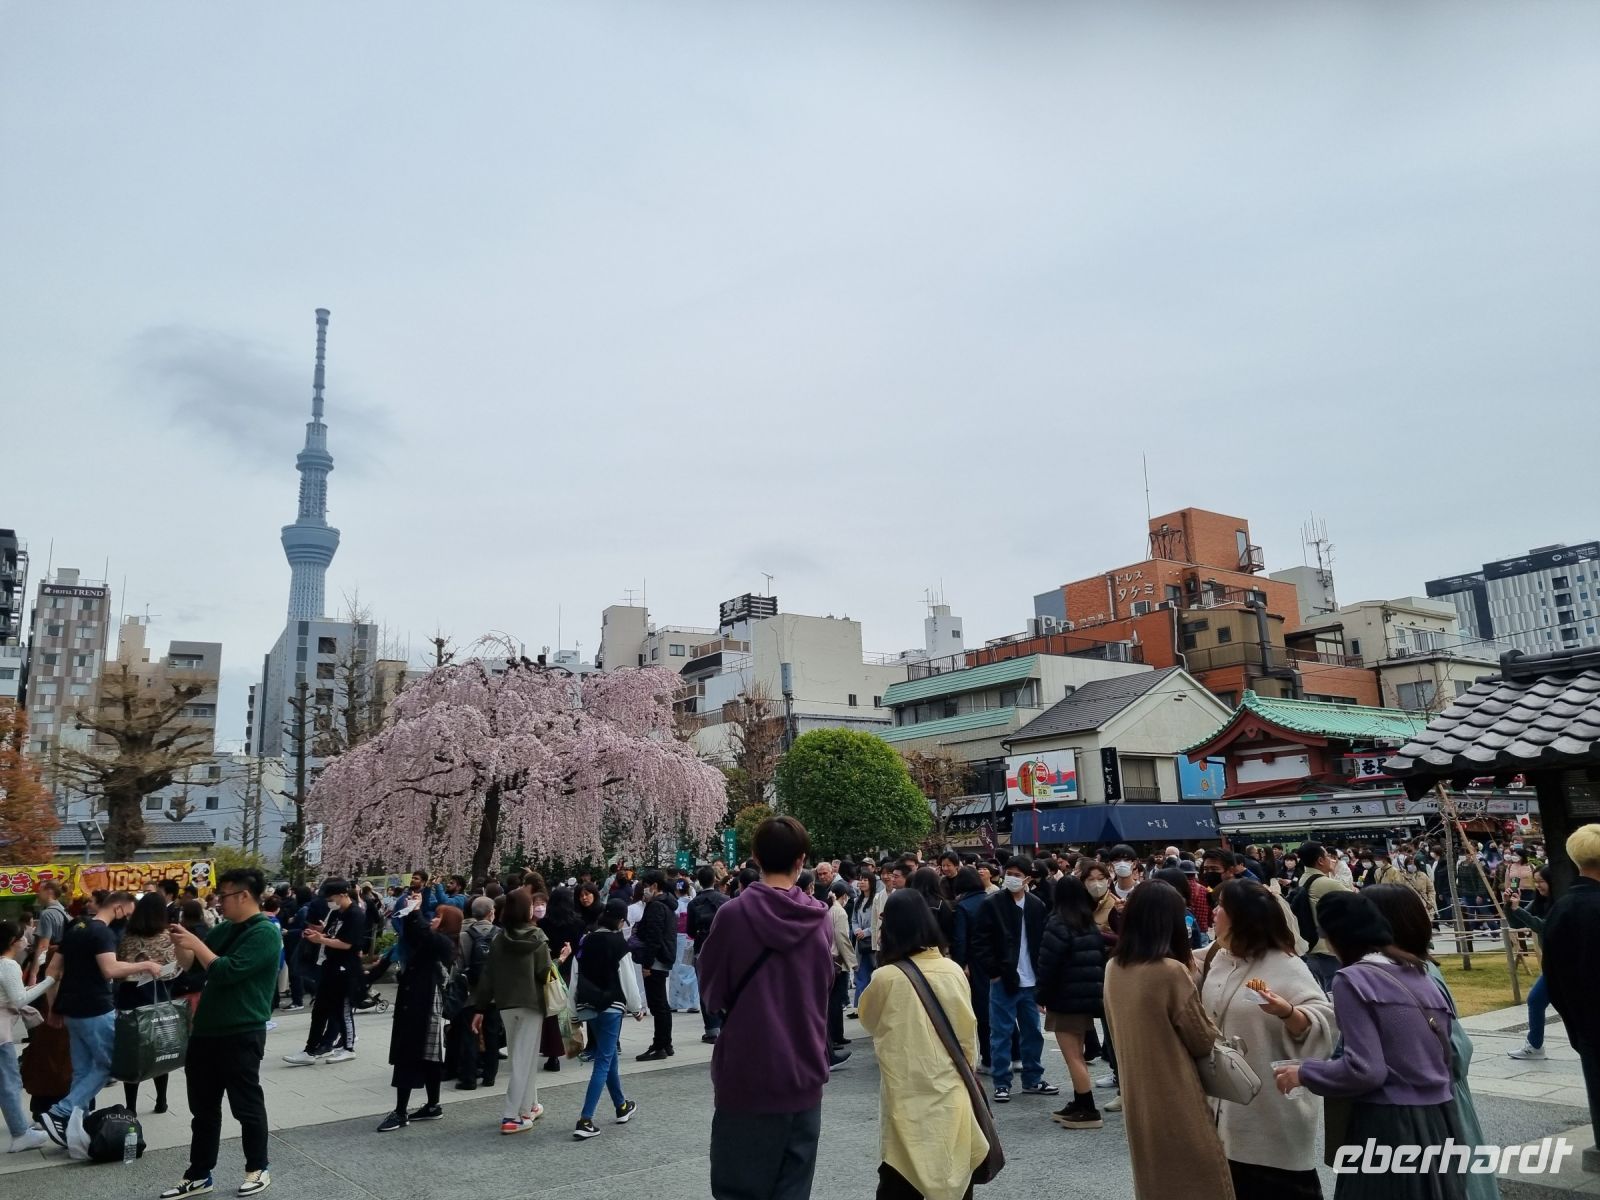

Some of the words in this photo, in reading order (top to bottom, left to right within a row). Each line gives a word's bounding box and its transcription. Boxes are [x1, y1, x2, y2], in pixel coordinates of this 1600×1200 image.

[1115, 570, 1143, 585] ドレス
[72, 589, 104, 597] TREND
[1118, 583, 1154, 601] タケミ
